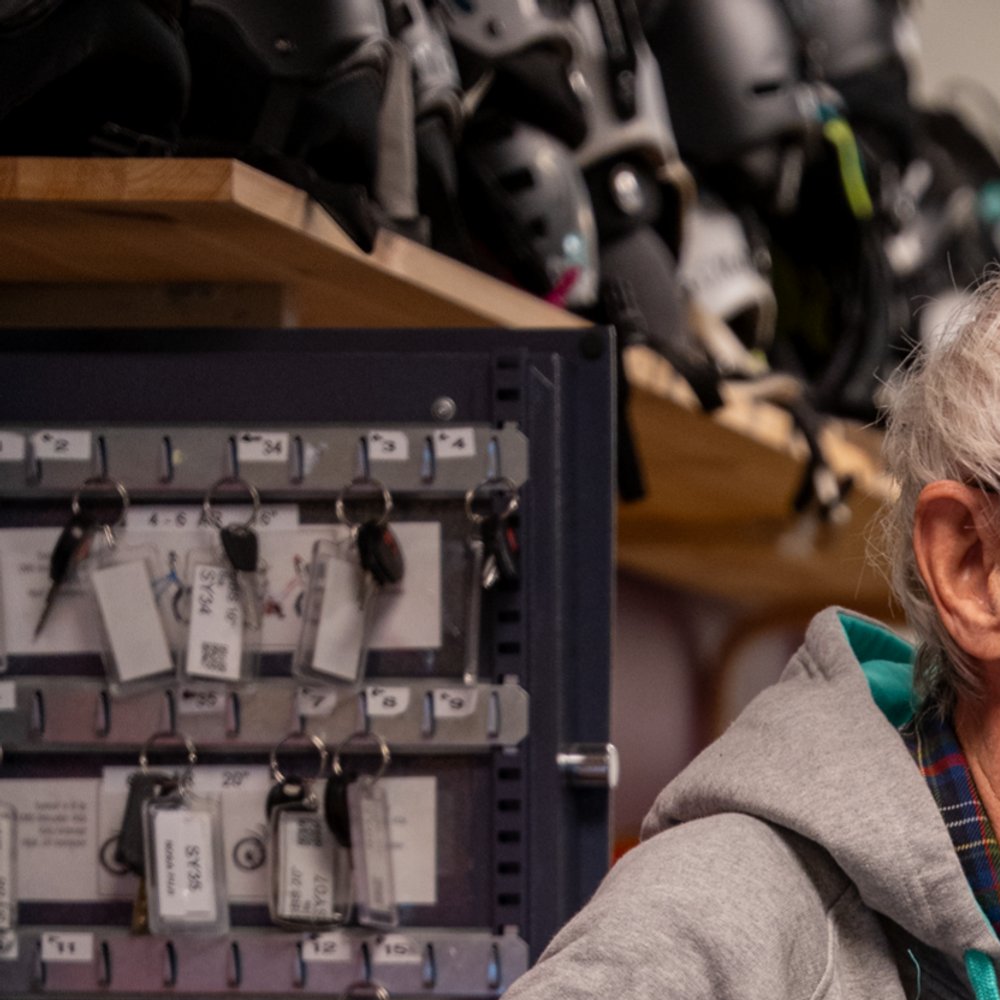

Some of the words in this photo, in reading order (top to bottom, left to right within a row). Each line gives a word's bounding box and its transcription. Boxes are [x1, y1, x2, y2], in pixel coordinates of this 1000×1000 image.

[262, 440, 284, 455] 34
[57, 941, 76, 954] 11
[313, 941, 336, 954] 12
